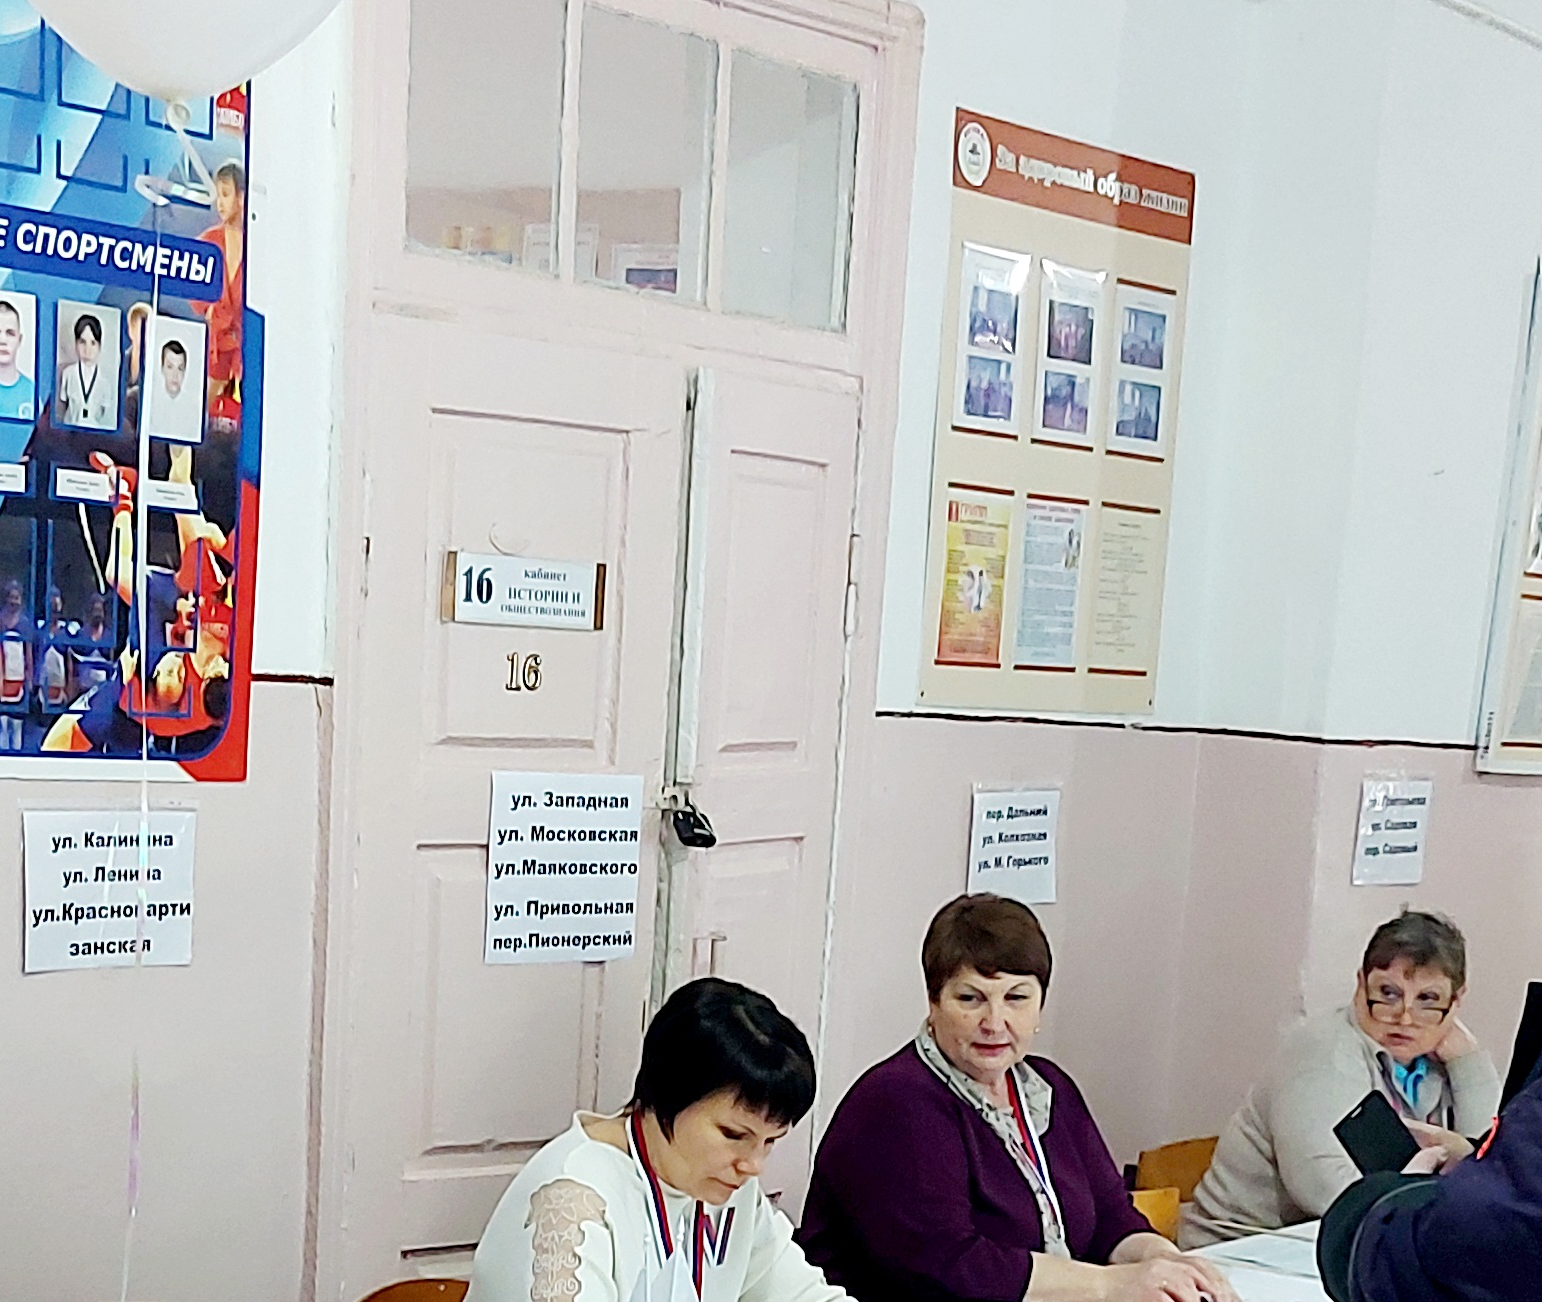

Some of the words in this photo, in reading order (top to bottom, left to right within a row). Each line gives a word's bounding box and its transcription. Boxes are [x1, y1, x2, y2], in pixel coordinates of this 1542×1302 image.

[16, 222, 215, 285] СПОРТСМЕНЫ
[462, 565, 493, 605] 16
[524, 568, 567, 582] кабинет
[505, 652, 543, 691] 16
[510, 794, 538, 811] ул.
[543, 791, 629, 811] Западная
[51, 836, 78, 853] ул.
[497, 829, 524, 845] ул.
[531, 825, 639, 843] Московская
[62, 871, 88, 888] ул.
[494, 859, 638, 880] ул.Маяковского
[493, 904, 520, 921] ул.
[526, 900, 634, 920] Привольная
